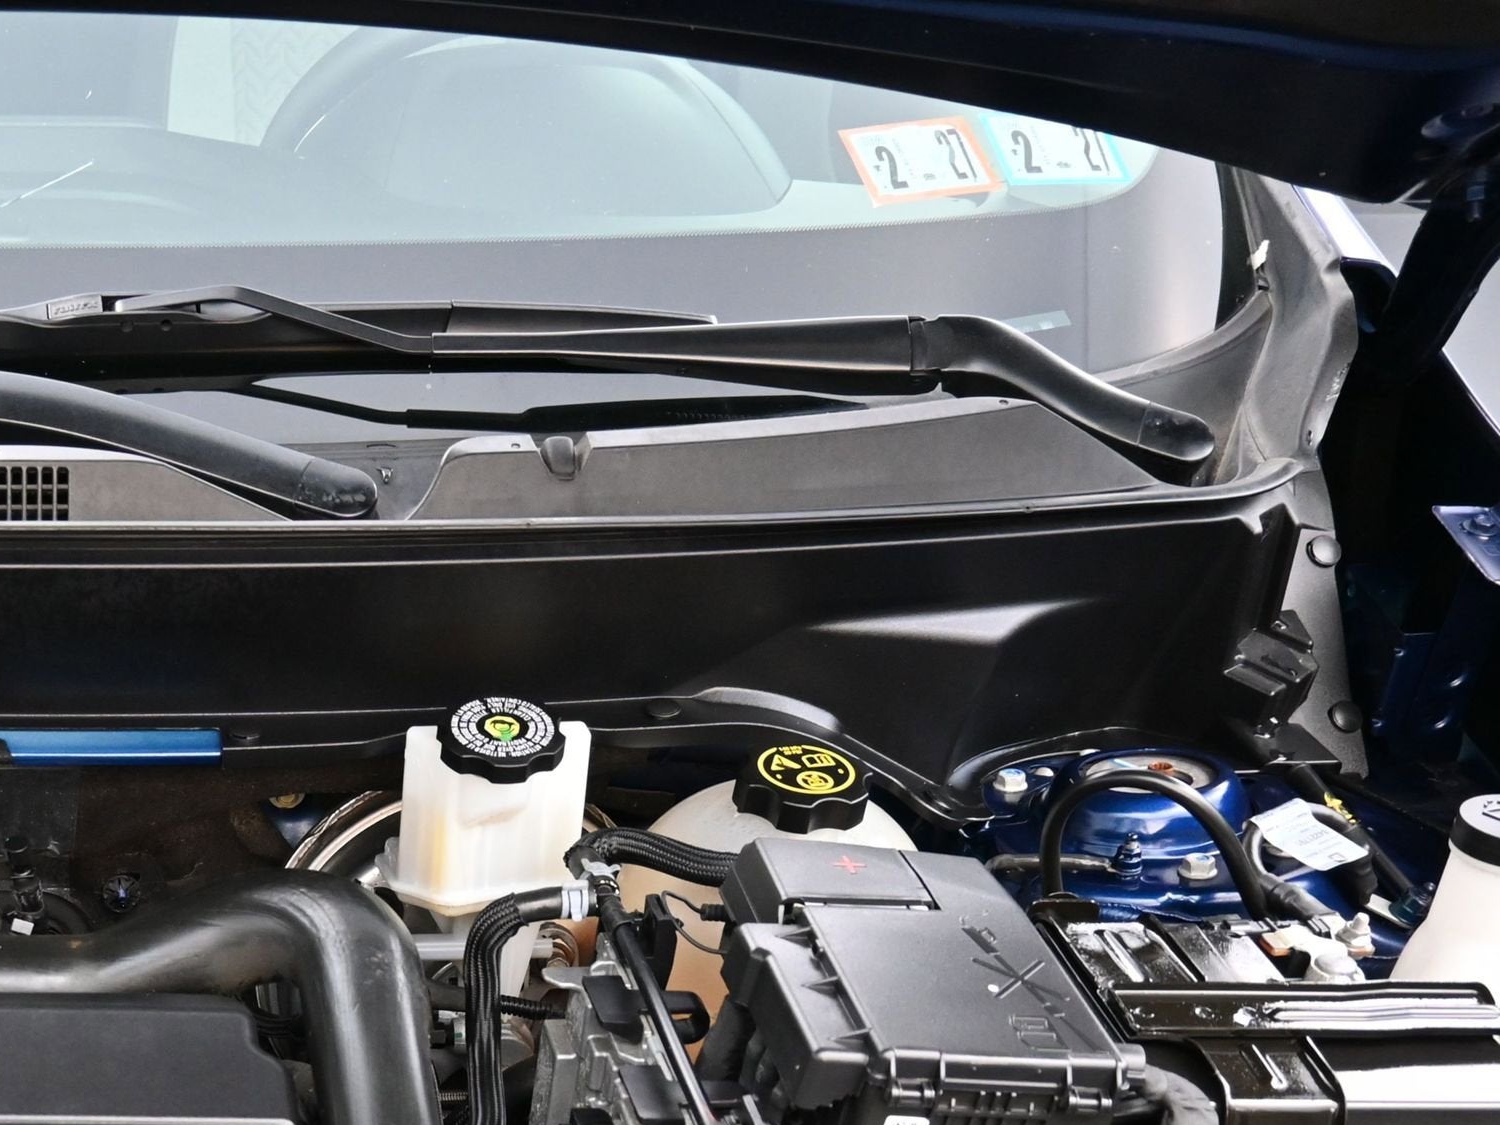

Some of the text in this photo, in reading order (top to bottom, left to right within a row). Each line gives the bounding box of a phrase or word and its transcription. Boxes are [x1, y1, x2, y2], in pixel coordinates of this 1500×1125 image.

[874, 127, 978, 190] 2 27
[1011, 129, 1043, 174] 2
